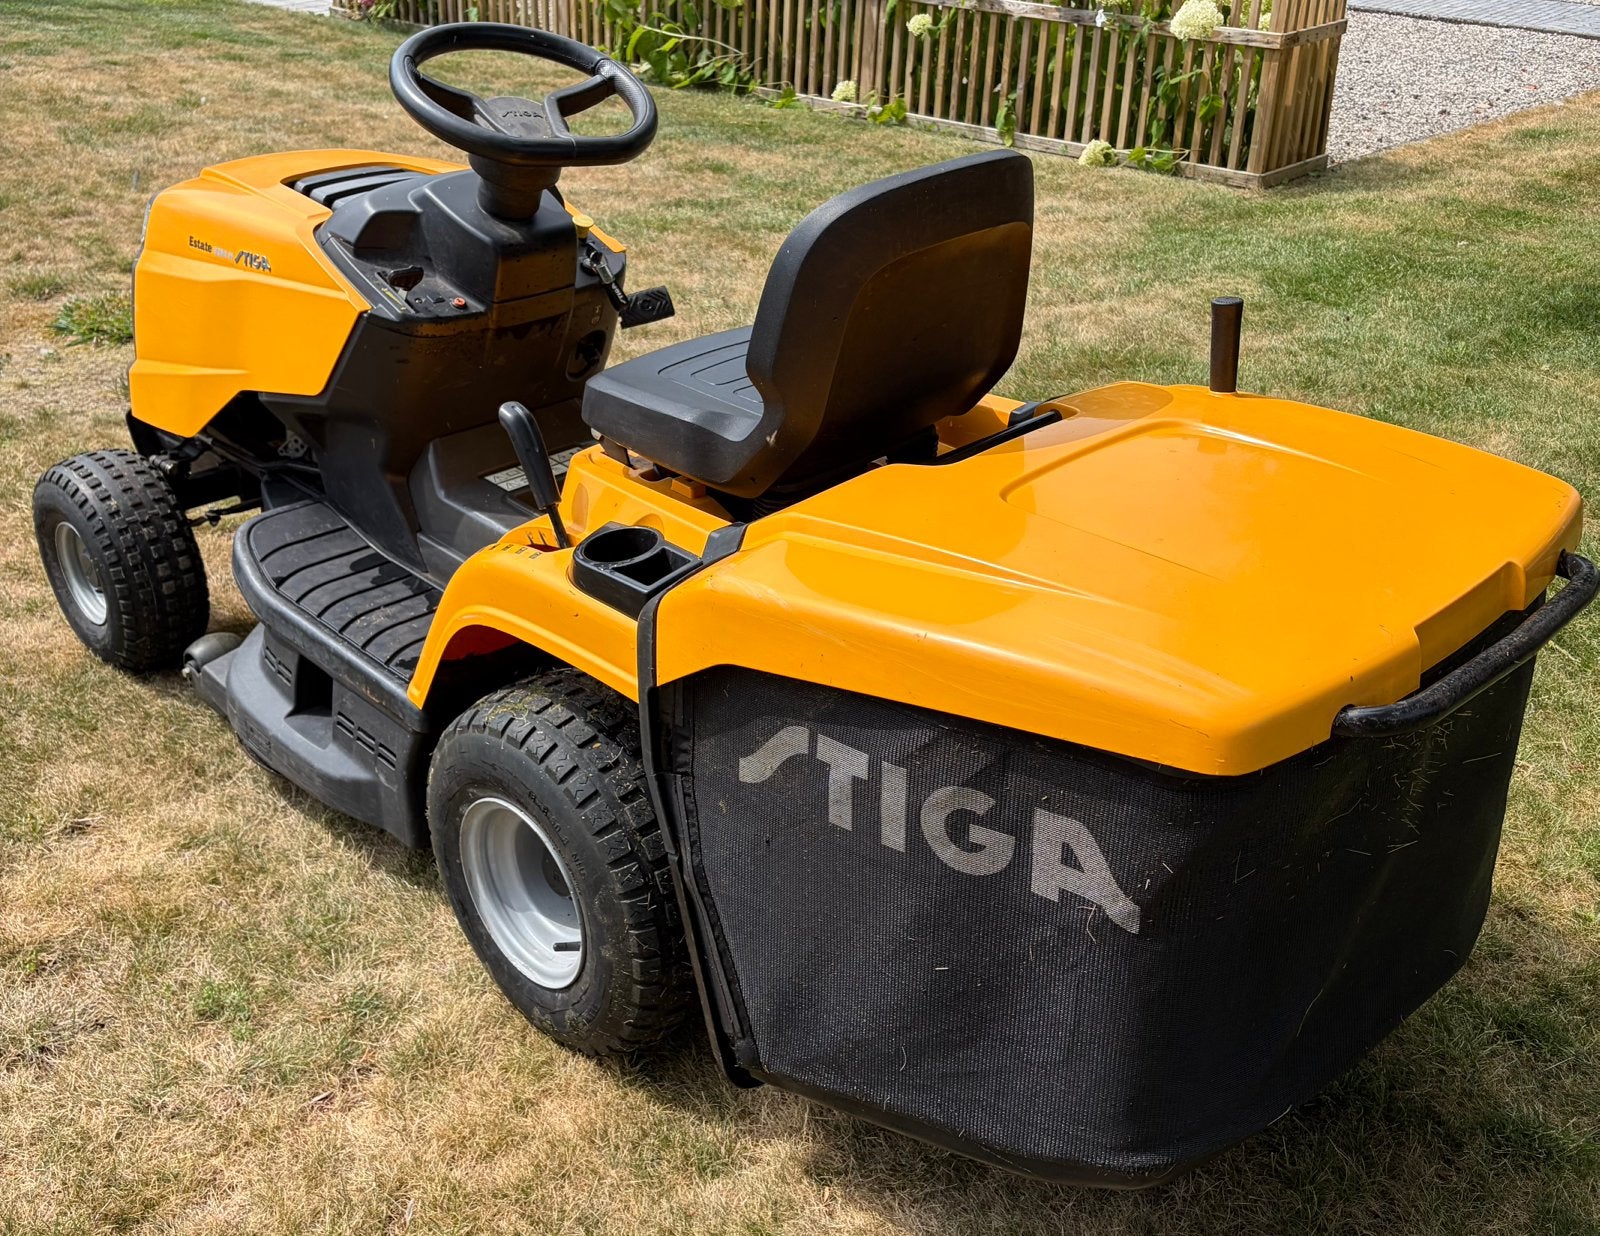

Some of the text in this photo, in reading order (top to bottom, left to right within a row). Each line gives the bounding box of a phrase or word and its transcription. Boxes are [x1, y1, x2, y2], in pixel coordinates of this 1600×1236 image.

[188, 234, 213, 253] Estate
[234, 250, 272, 274] STIGA
[738, 725, 1141, 934] STIGA
